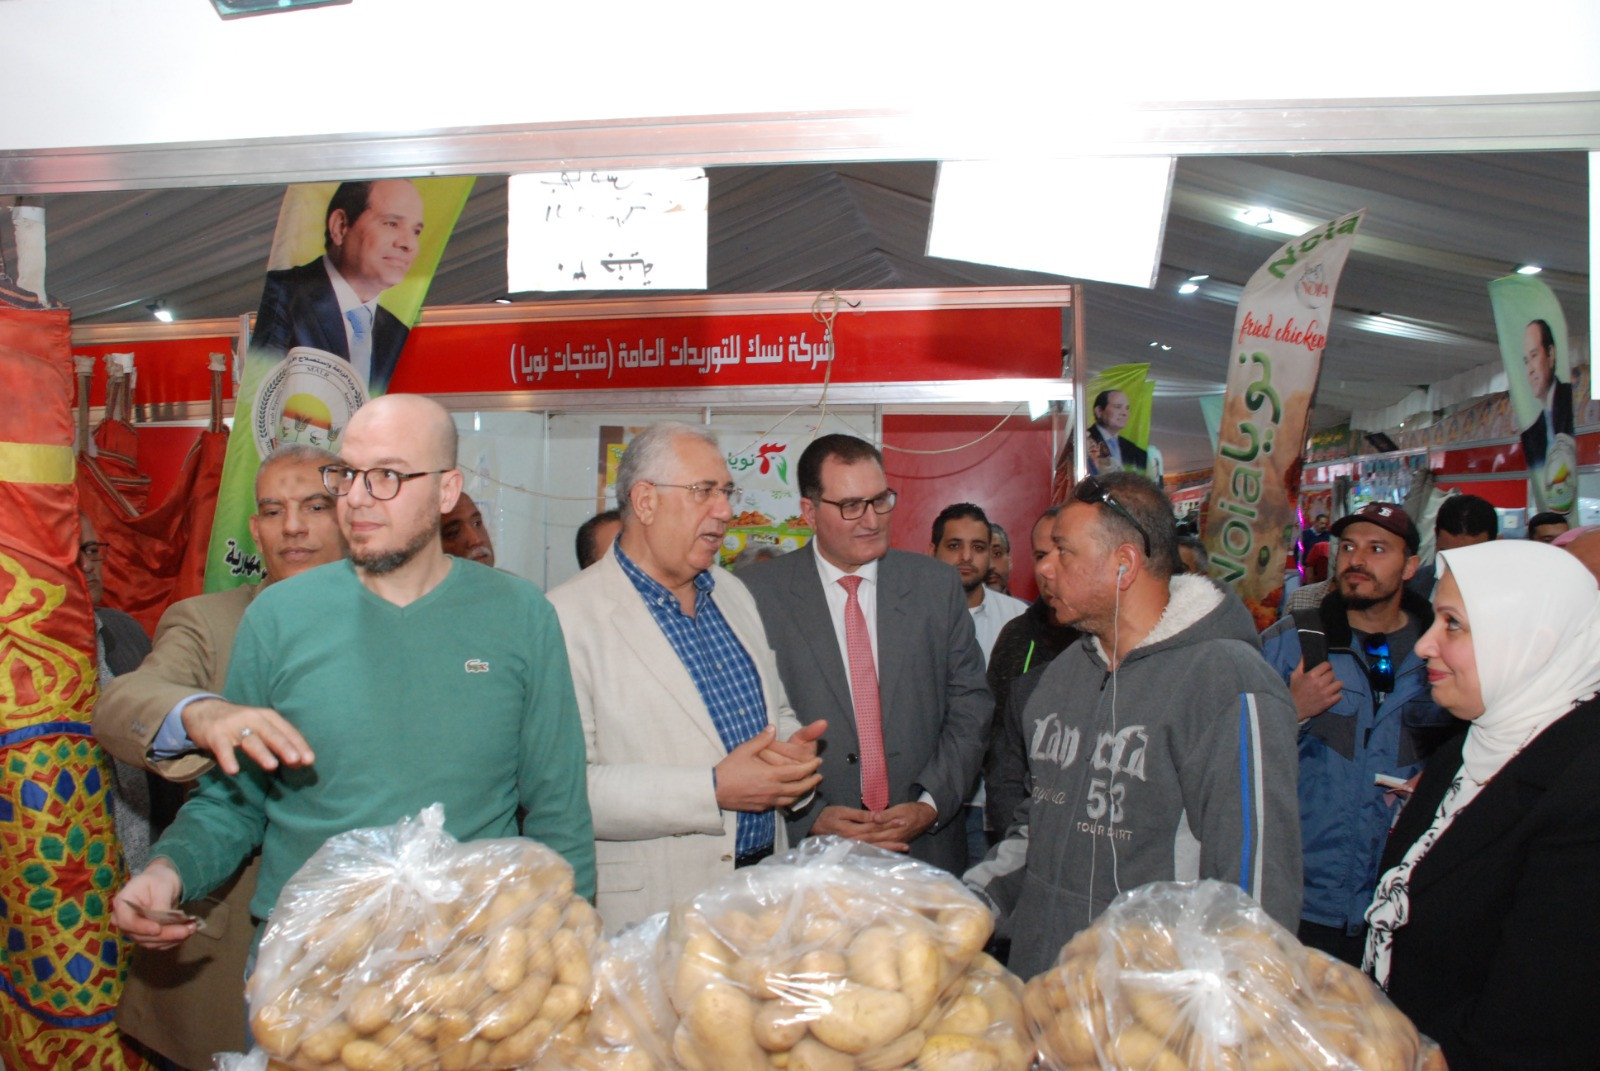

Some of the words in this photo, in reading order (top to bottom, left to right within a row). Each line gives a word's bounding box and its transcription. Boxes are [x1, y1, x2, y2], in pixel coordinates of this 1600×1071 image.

[1268, 215, 1360, 279] Noia
[745, 333, 784, 364] نسك
[788, 328, 835, 370] شركة
[1237, 311, 1274, 345] fried
[1274, 317, 1328, 351] chicken
[618, 337, 664, 368] العامة
[669, 334, 741, 374] للتوريدات
[1220, 351, 1281, 462] نويا
